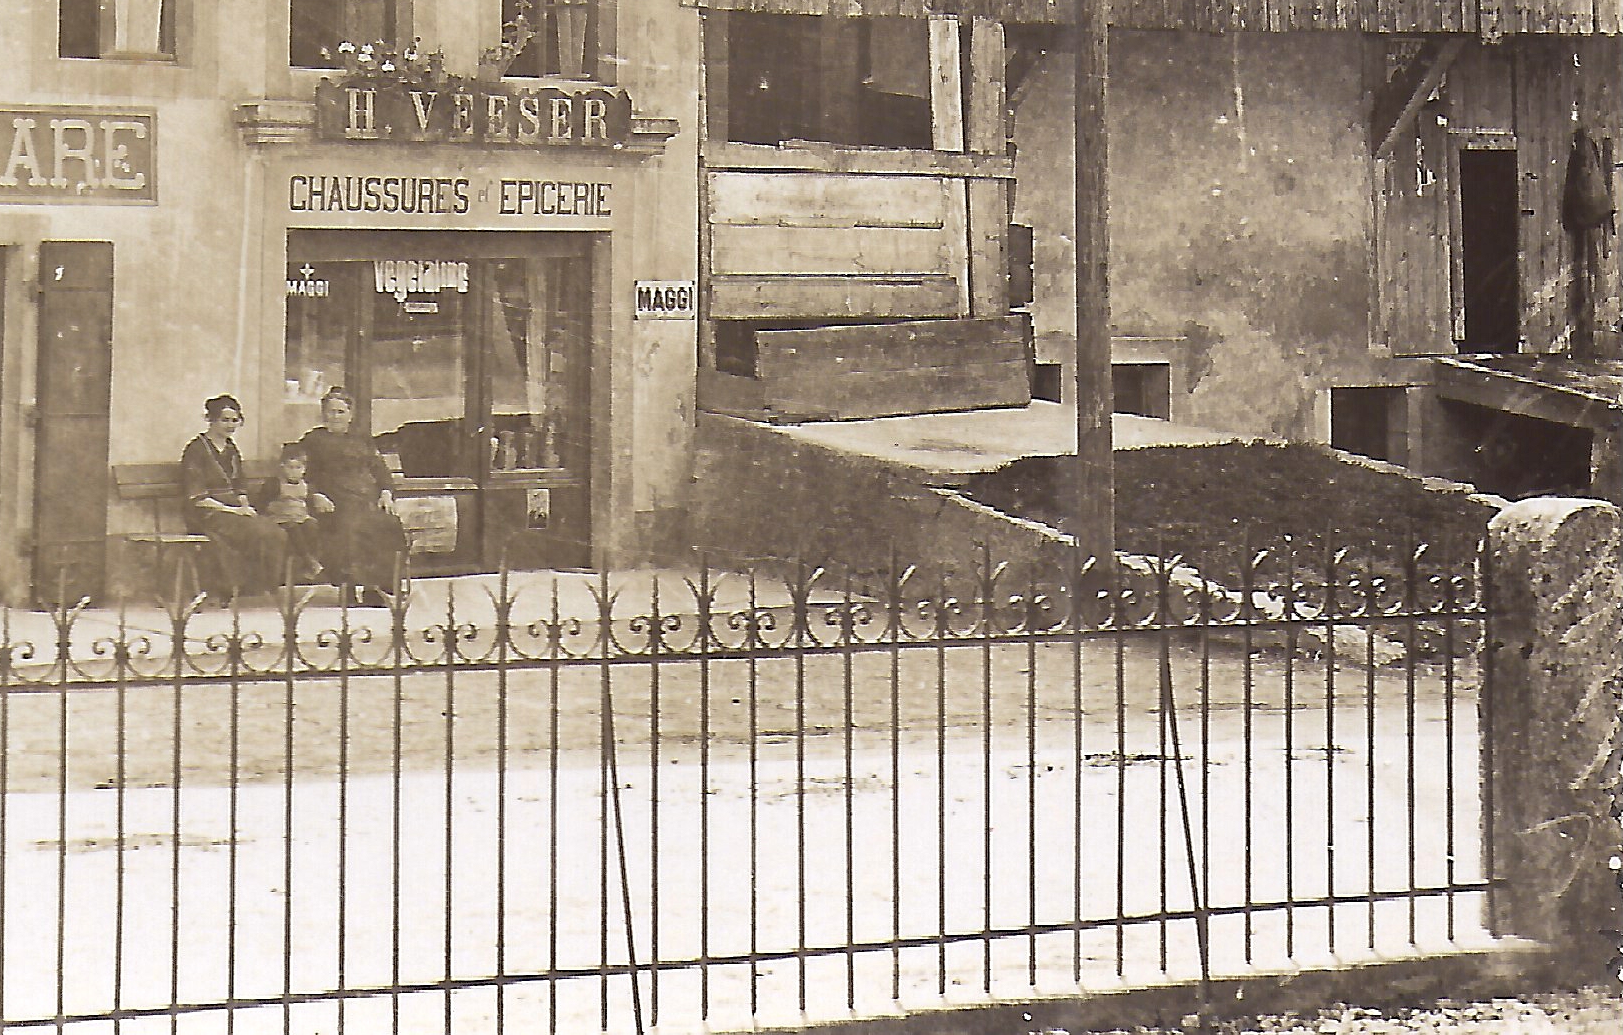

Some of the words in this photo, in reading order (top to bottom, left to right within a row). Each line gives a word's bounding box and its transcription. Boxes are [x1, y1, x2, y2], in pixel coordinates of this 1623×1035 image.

[408, 88, 612, 146] VEESER
[288, 174, 471, 215] CHAUSSURES
[499, 178, 613, 216] EPICERIE
[286, 279, 329, 297] MAGGI
[637, 286, 693, 312] MAGGI
